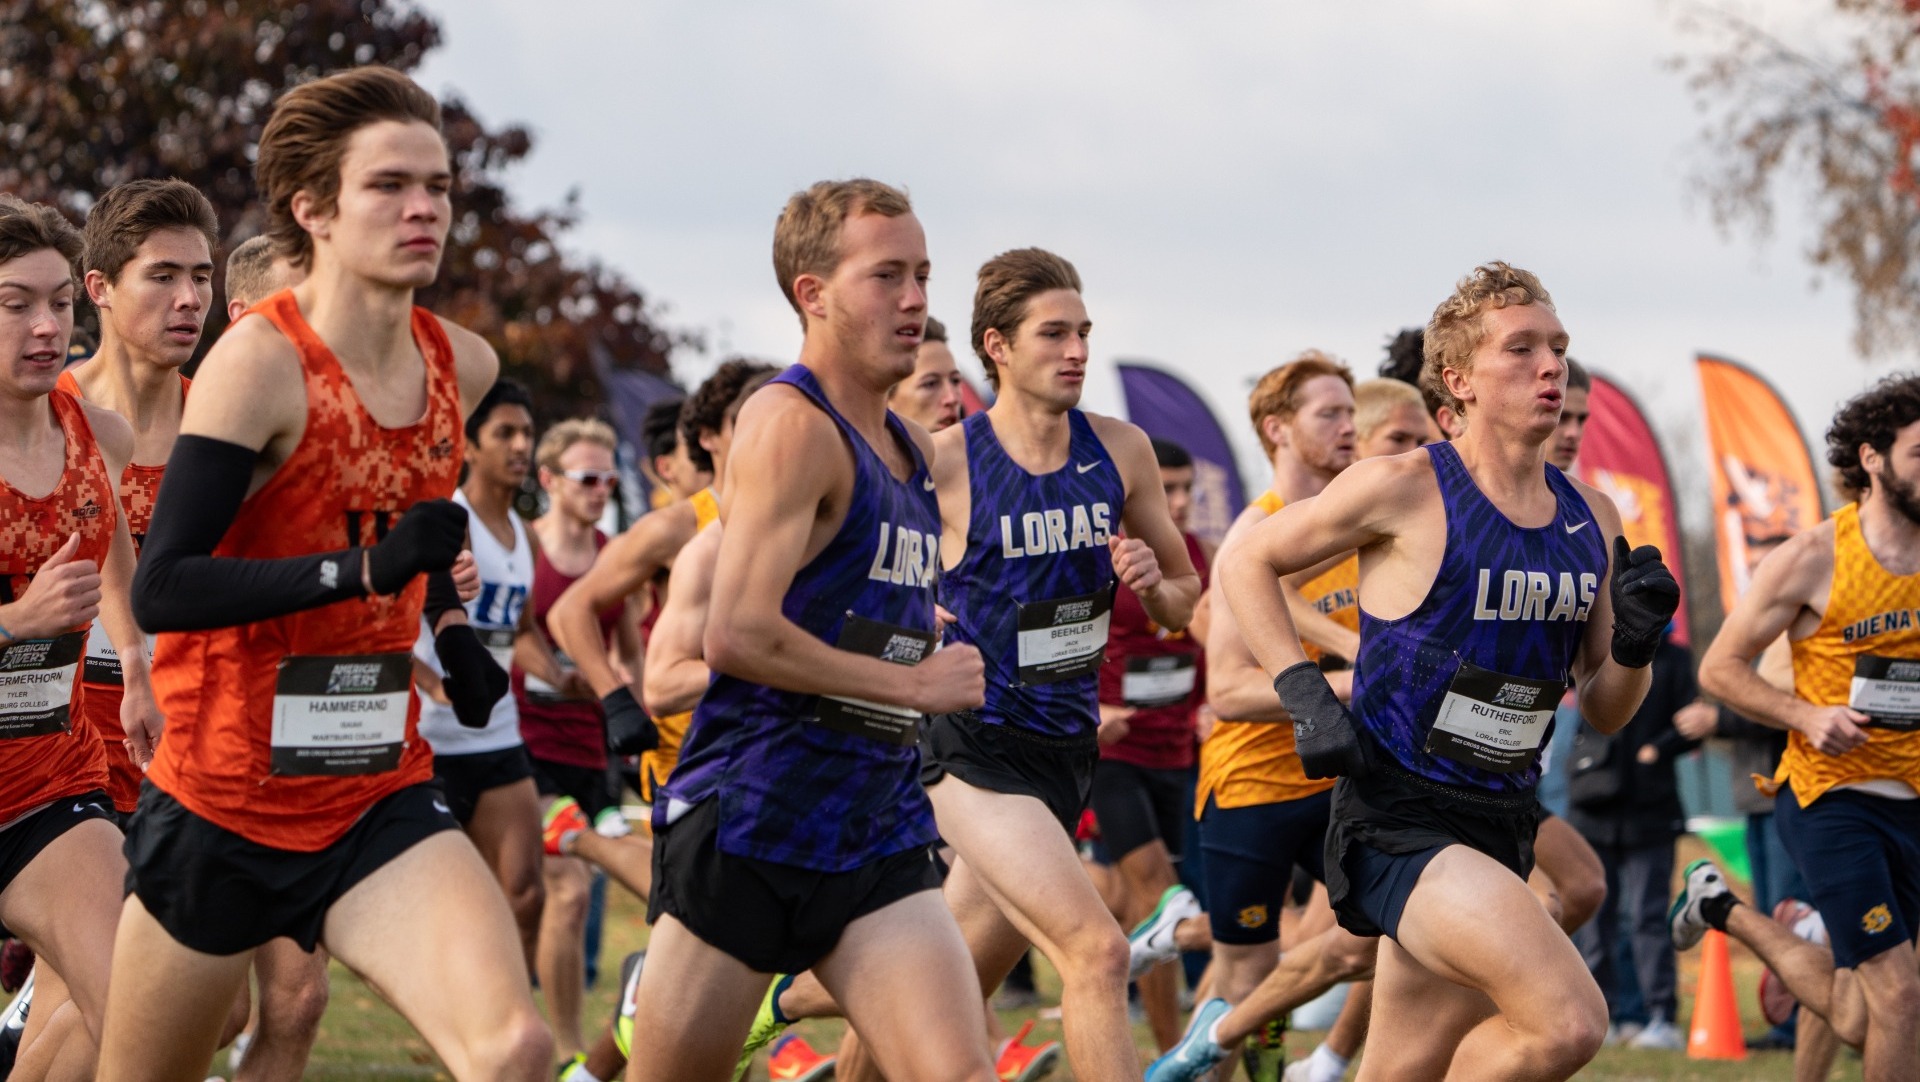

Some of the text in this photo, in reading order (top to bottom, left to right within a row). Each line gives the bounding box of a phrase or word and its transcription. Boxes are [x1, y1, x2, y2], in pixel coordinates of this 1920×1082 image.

[1000, 503, 1112, 559] LORAS
[868, 521, 942, 588] LORA
[1473, 568, 1597, 622] LORAS
[1051, 624, 1094, 639] BEEHLER
[1843, 609, 1911, 643] BUENA
[6, 643, 52, 654] AMERICAN
[1501, 682, 1541, 694] AMERICAN
[309, 699, 388, 713] HAMMERAND
[1470, 703, 1537, 725] RUTHERFORD
[1475, 731, 1498, 744] LORAS
[1498, 728, 1513, 736] ERIC
[1463, 740, 1480, 750] CROSS
[1480, 745, 1503, 757] COUNTRY
